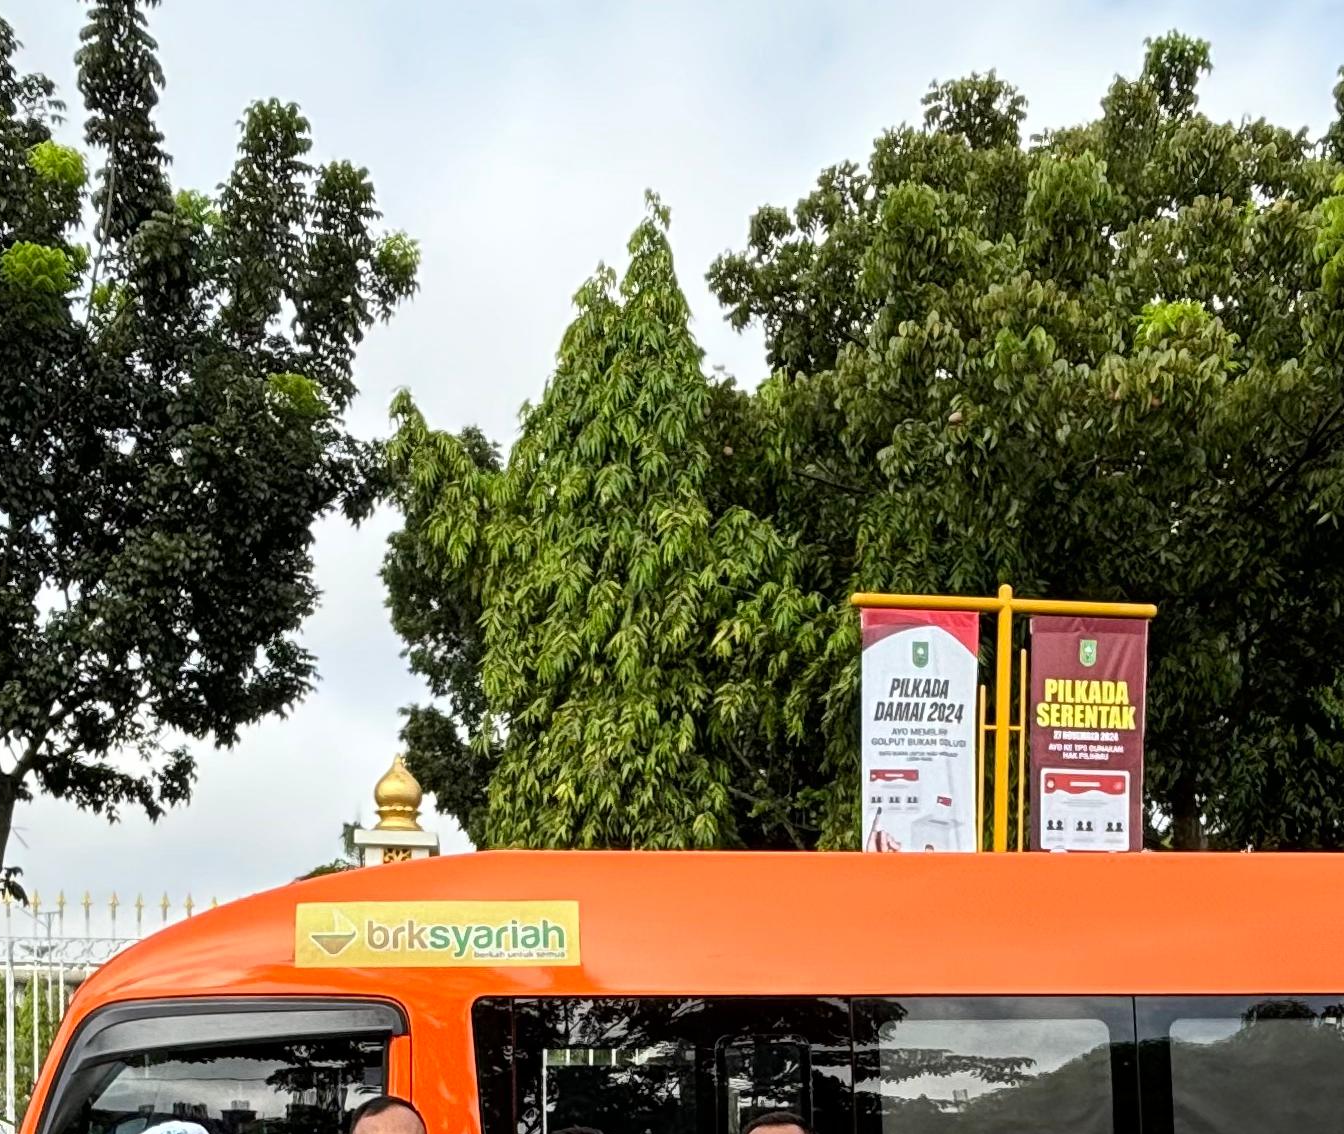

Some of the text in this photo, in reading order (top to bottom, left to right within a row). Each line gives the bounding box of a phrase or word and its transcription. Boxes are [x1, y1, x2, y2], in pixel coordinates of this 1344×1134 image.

[888, 678, 950, 699] PILKADA
[1044, 678, 1130, 705] PILKADA
[873, 701, 965, 724] DAMAI 2024
[1036, 702, 1136, 731] SERENTAK
[367, 920, 566, 957] brksyariah
